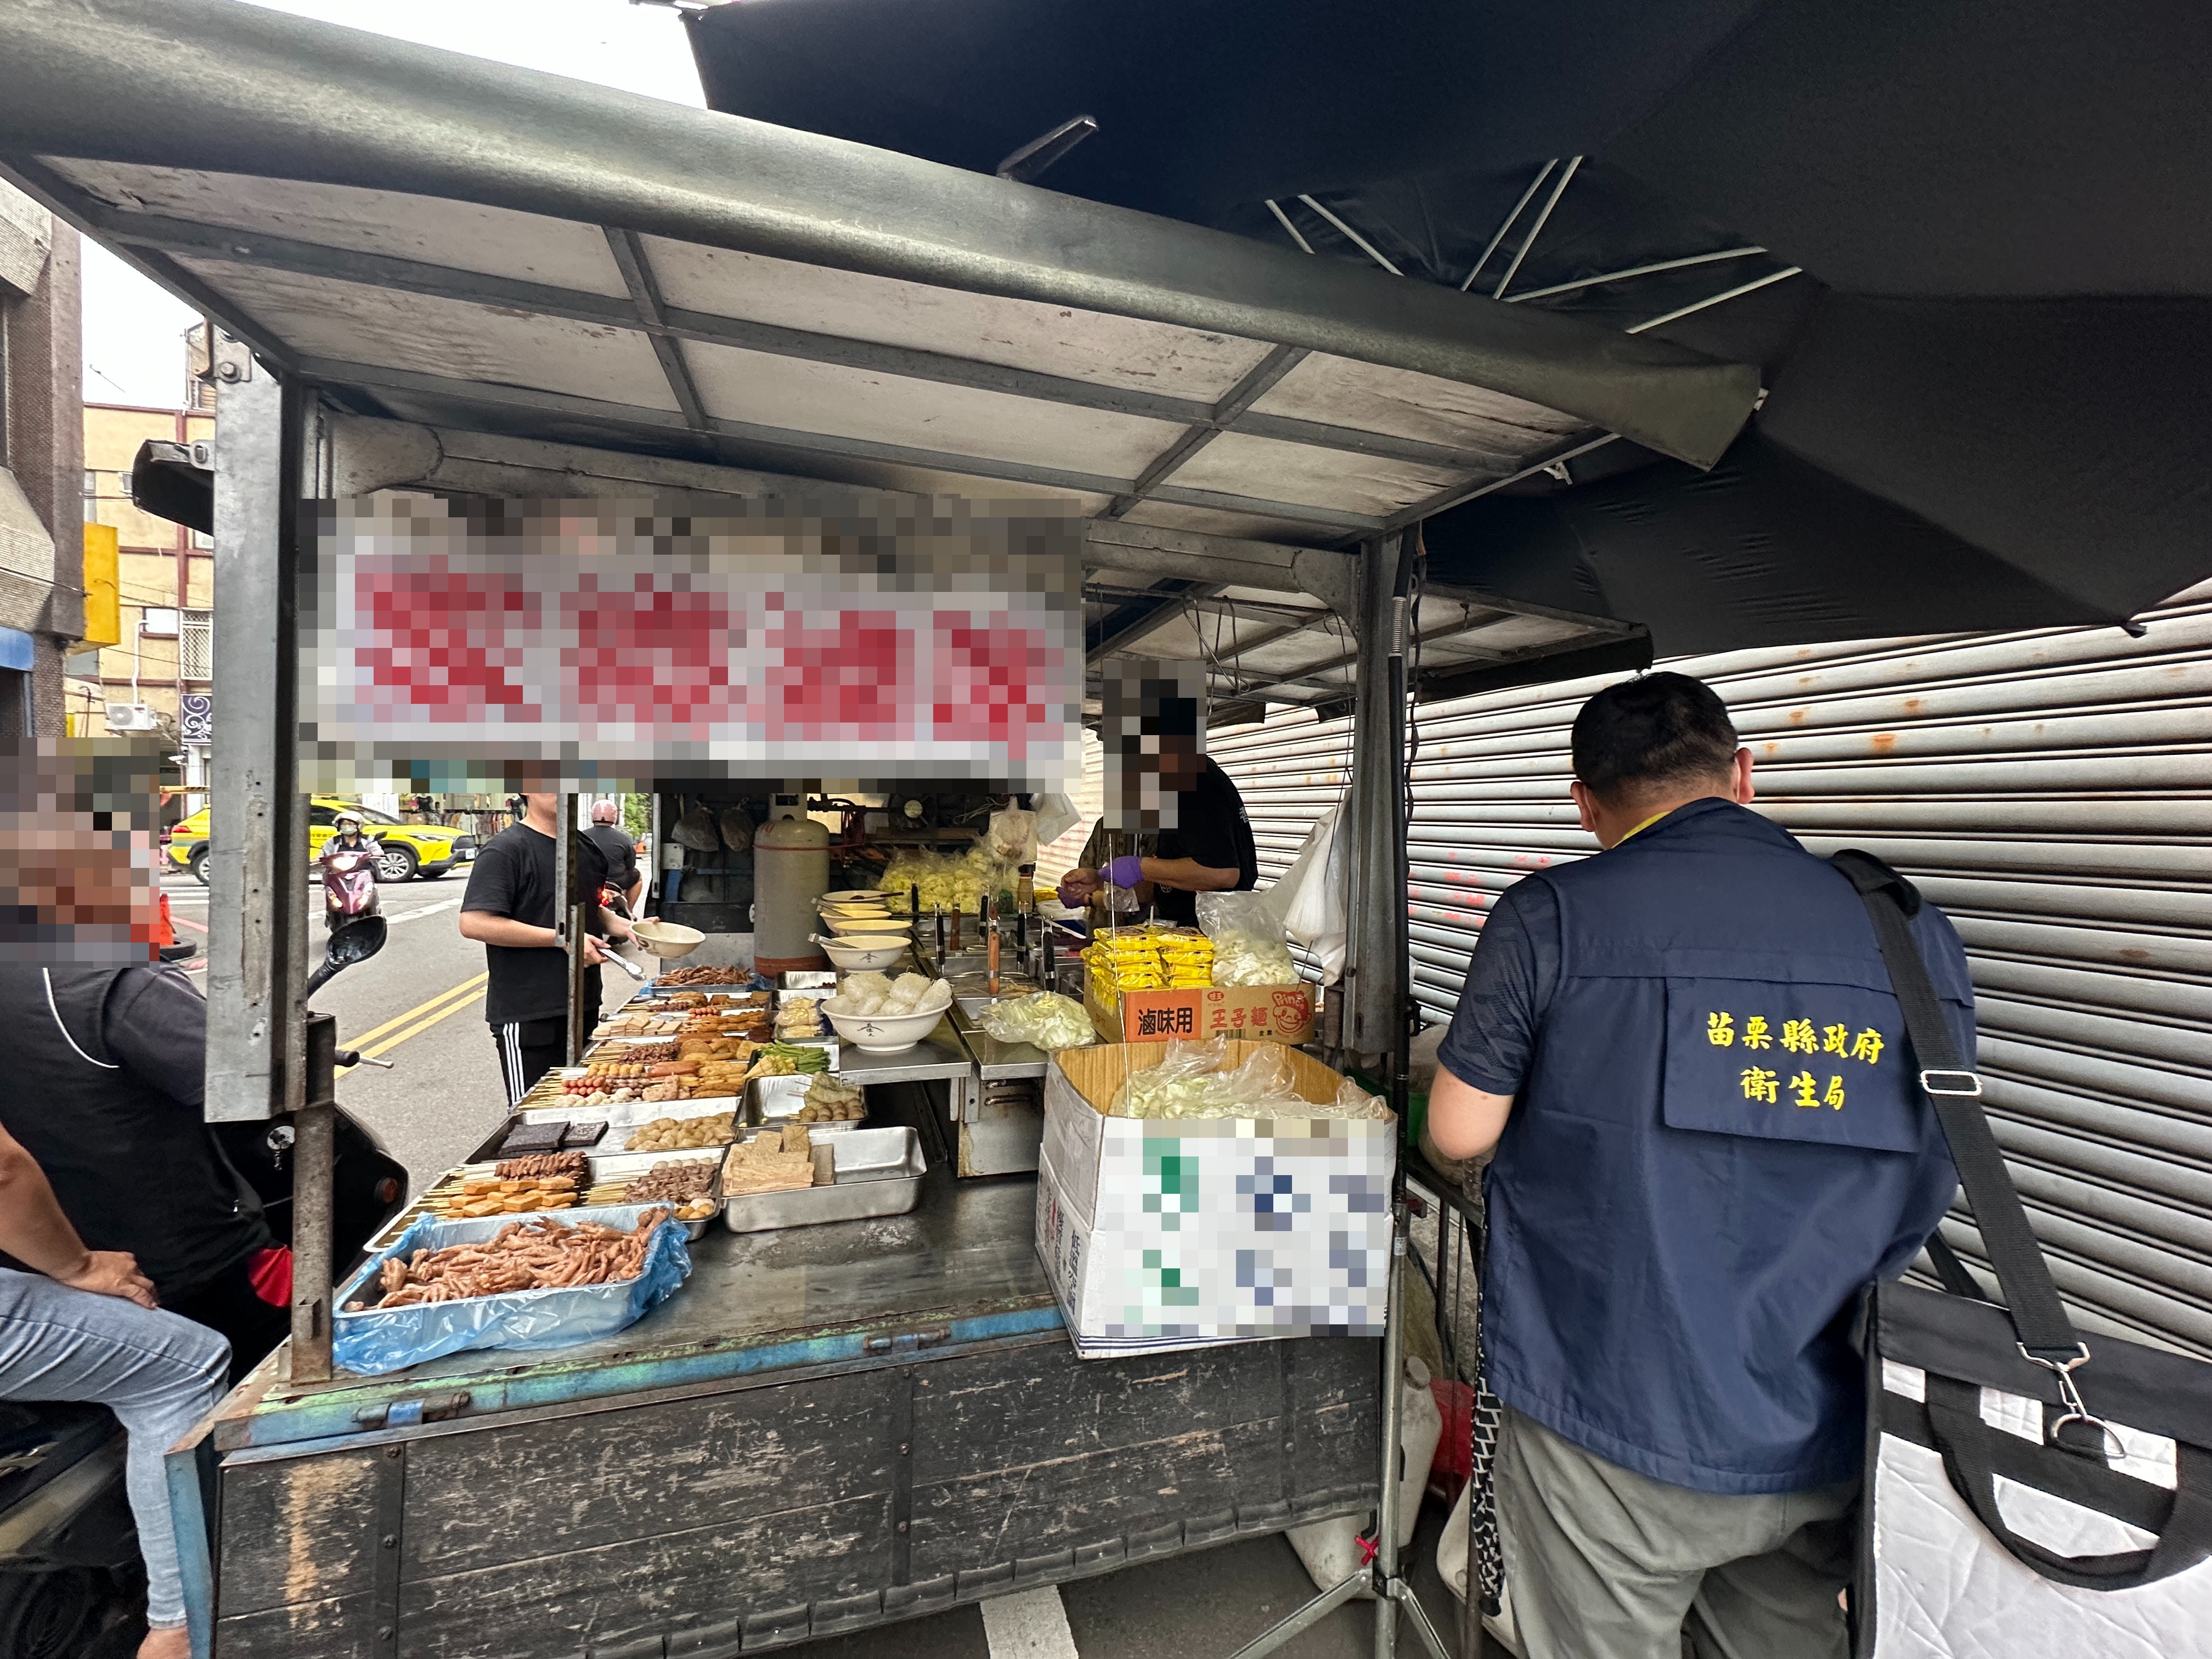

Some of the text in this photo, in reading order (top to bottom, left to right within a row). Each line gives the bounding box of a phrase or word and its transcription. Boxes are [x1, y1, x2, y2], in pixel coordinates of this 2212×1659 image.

[1138, 1007, 1193, 1036] 滷味用
[1706, 1011, 1885, 1065] 苗栗縣政府
[1740, 1065, 1846, 1111] 衛生局
